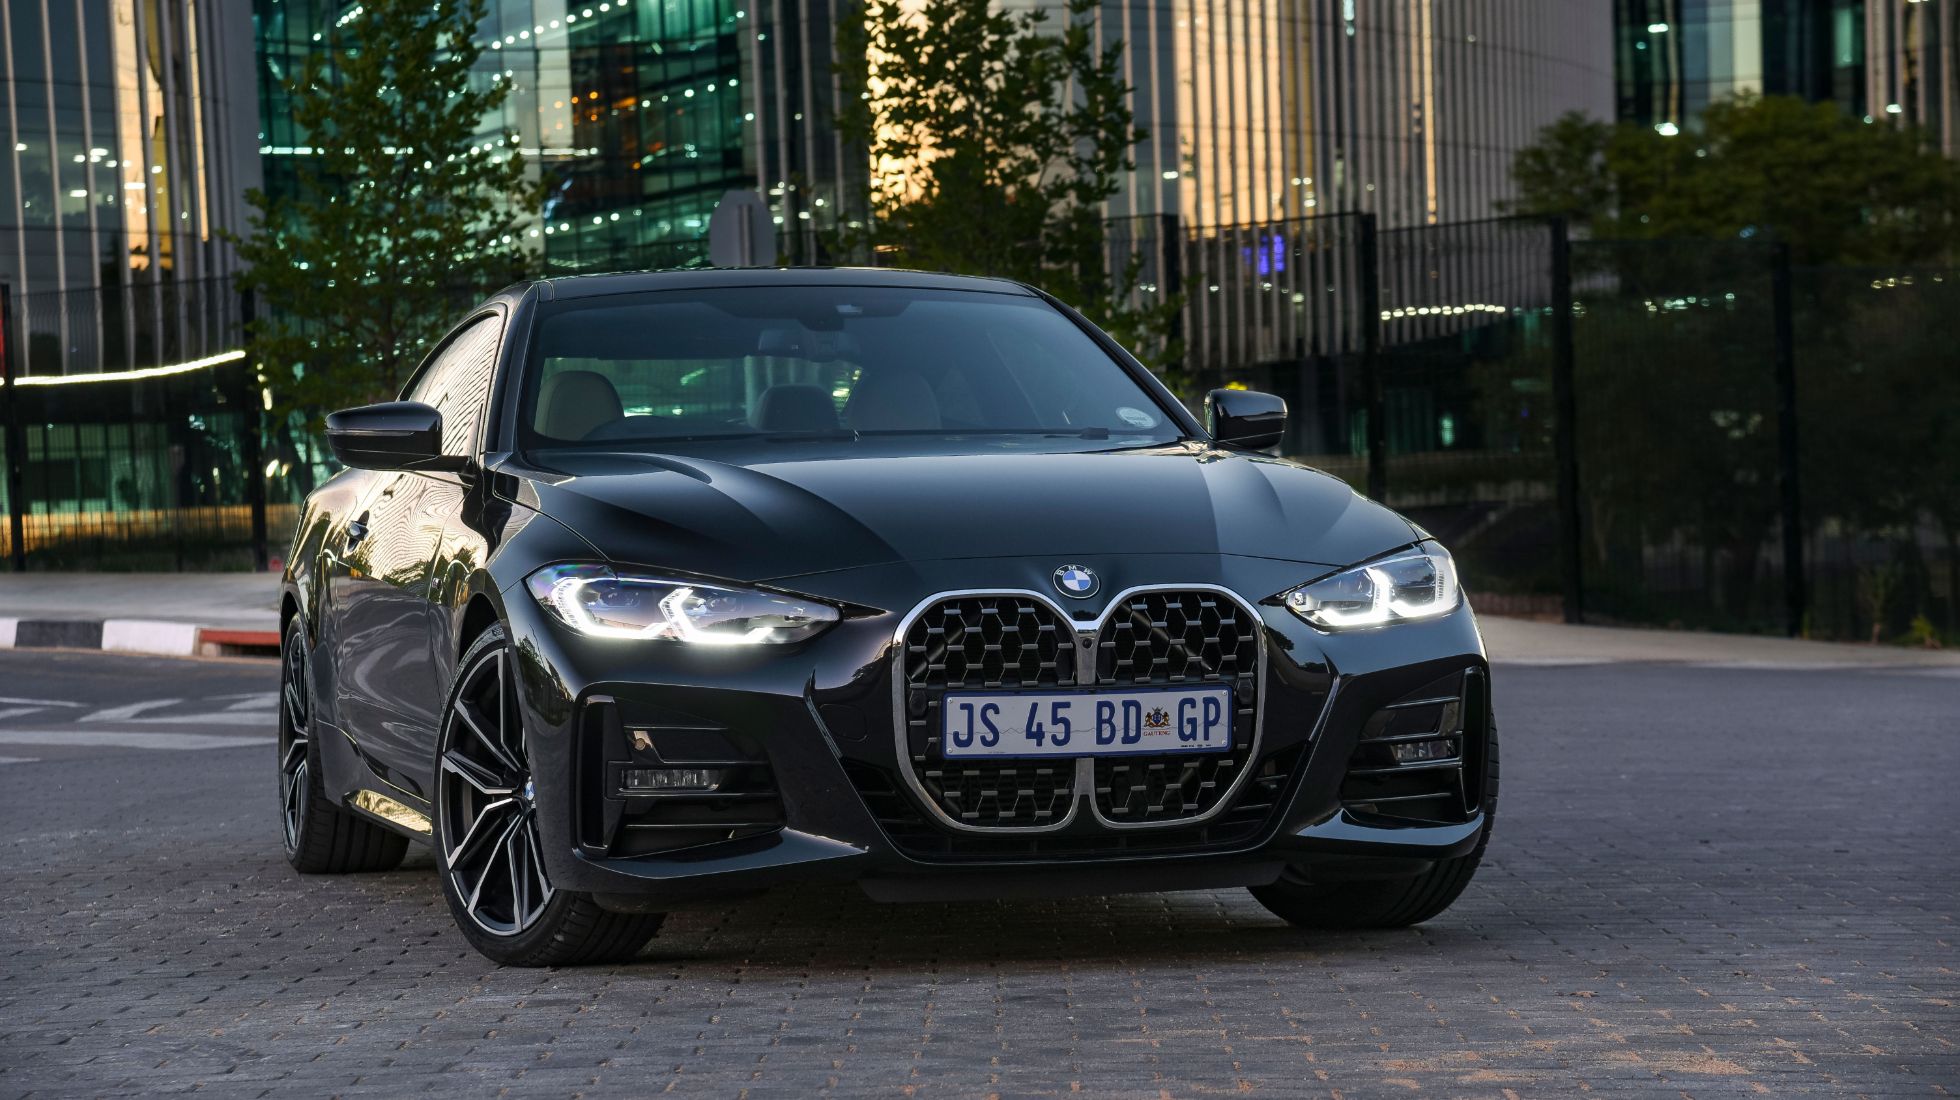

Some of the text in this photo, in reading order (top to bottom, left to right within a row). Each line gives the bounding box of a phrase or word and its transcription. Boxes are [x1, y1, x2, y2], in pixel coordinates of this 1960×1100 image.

[1055, 564, 1093, 577] BMW
[953, 696, 1222, 748] JS 45 BD GP
